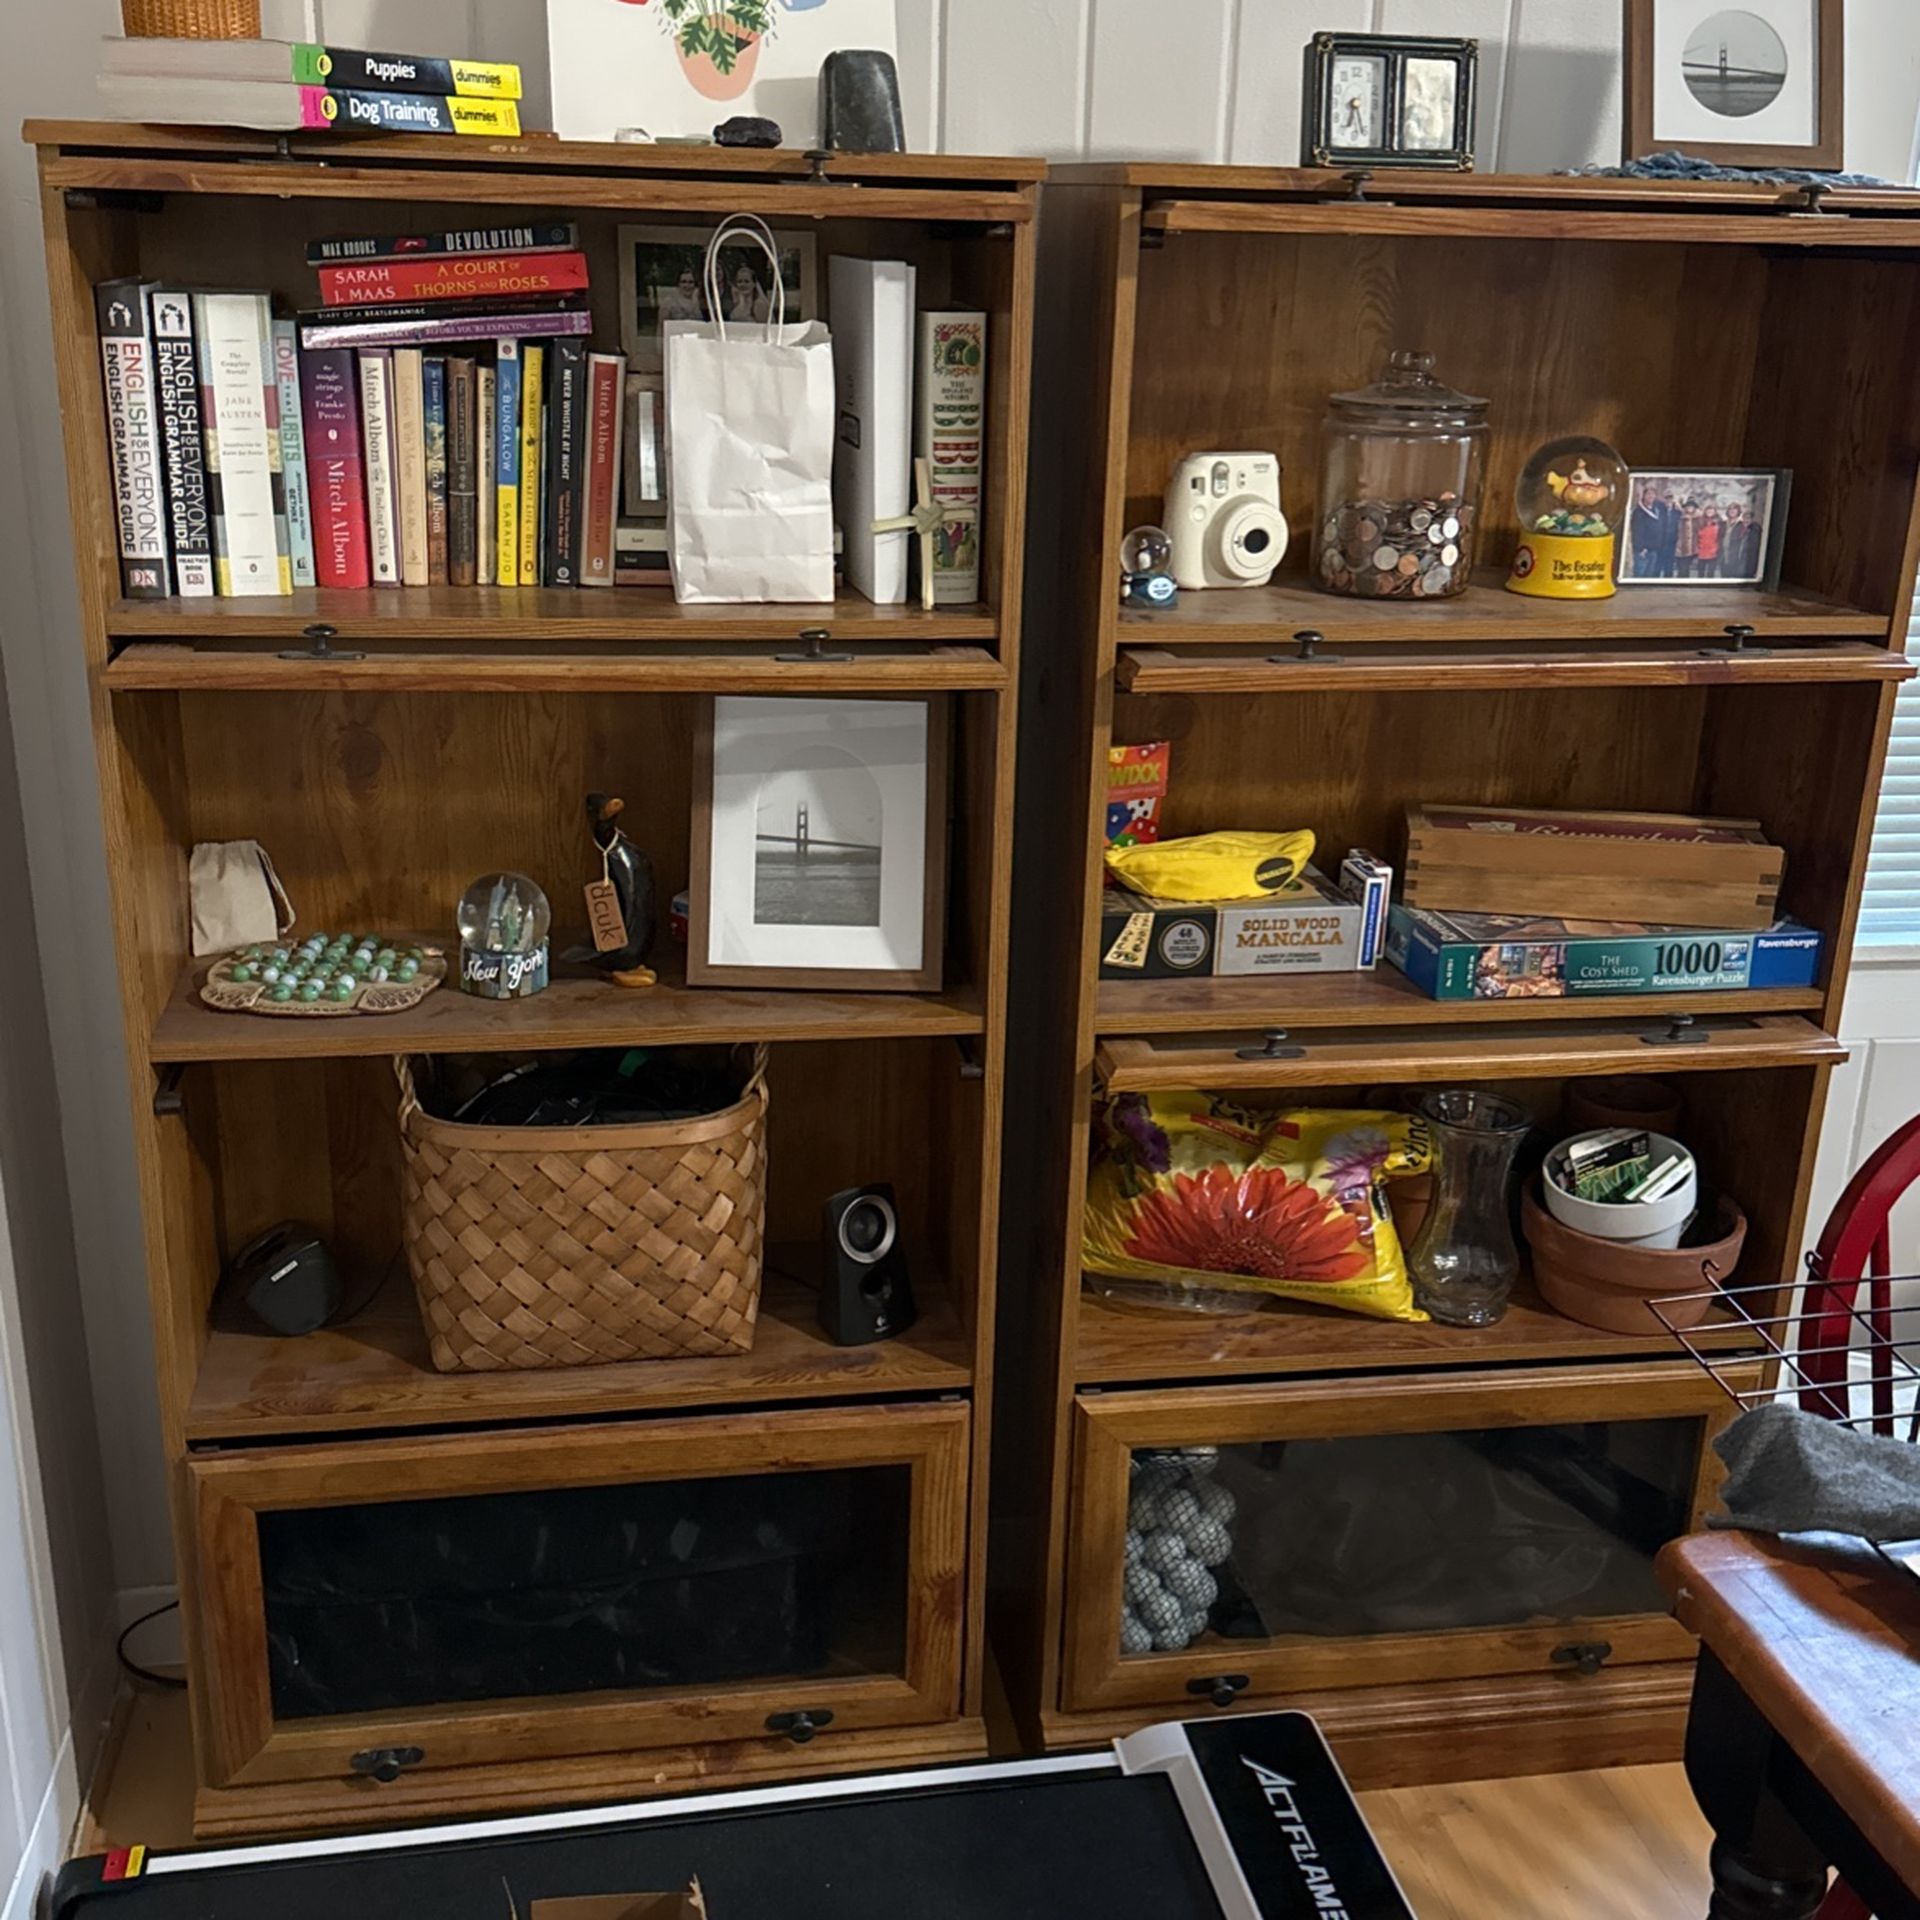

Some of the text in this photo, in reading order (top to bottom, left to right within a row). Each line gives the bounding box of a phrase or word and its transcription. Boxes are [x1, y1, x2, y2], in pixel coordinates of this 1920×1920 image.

[365, 58, 416, 82] Puppies
[455, 66, 502, 86] dummies
[350, 97, 380, 124] Dog
[381, 100, 440, 128] Training
[454, 106, 498, 123] dummies
[321, 240, 377, 257] MAX BROOKS
[445, 228, 534, 251] DEVOLUTION
[335, 268, 390, 284] SARAH
[437, 260, 521, 277] A COURT OF
[334, 286, 397, 304] J. MAAS
[413, 275, 550, 297] THORNS AND ROSES
[275, 336, 295, 383] LOVE
[315, 383, 344, 393] strings
[364, 366, 381, 409] Mitch
[225, 396, 252, 406] JANE
[219, 411, 262, 420] AUSTEN
[561, 368, 573, 481] NEVER WHISTLE AT NIGHT
[597, 379, 612, 464] Mitch Albom
[281, 414, 301, 462] LASTS
[367, 412, 385, 463] Albom
[502, 394, 512, 472] BUNGALOW
[105, 343, 136, 553] ENGLISH GRAMMAR GUIDE
[123, 342, 159, 552] ENGLISH FOR EVERYONE
[158, 342, 189, 550] ENGLISH GRAMMAR GUIDE
[173, 342, 209, 549] ENGLISH FOR EVERYONE
[430, 452, 444, 533] Mitch Albom
[327, 460, 350, 575] Mitch Albom
[374, 486, 388, 527] Finding
[503, 502, 512, 573] SARAH JIO
[1552, 559, 1572, 572] The
[1110, 762, 1161, 786] WIXX
[590, 885, 621, 941] dcuk
[1242, 917, 1341, 932] SOLID WOOD
[1236, 931, 1344, 948] MANCALA
[1757, 938, 1820, 949] Ravensburger
[463, 959, 499, 981] New
[1601, 955, 1621, 966] THE
[1653, 941, 1722, 976] 1000
[1580, 966, 1639, 979] COSY SHED
[1652, 974, 1715, 988] Ravensburger
[1716, 971, 1746, 984] Puzzle
